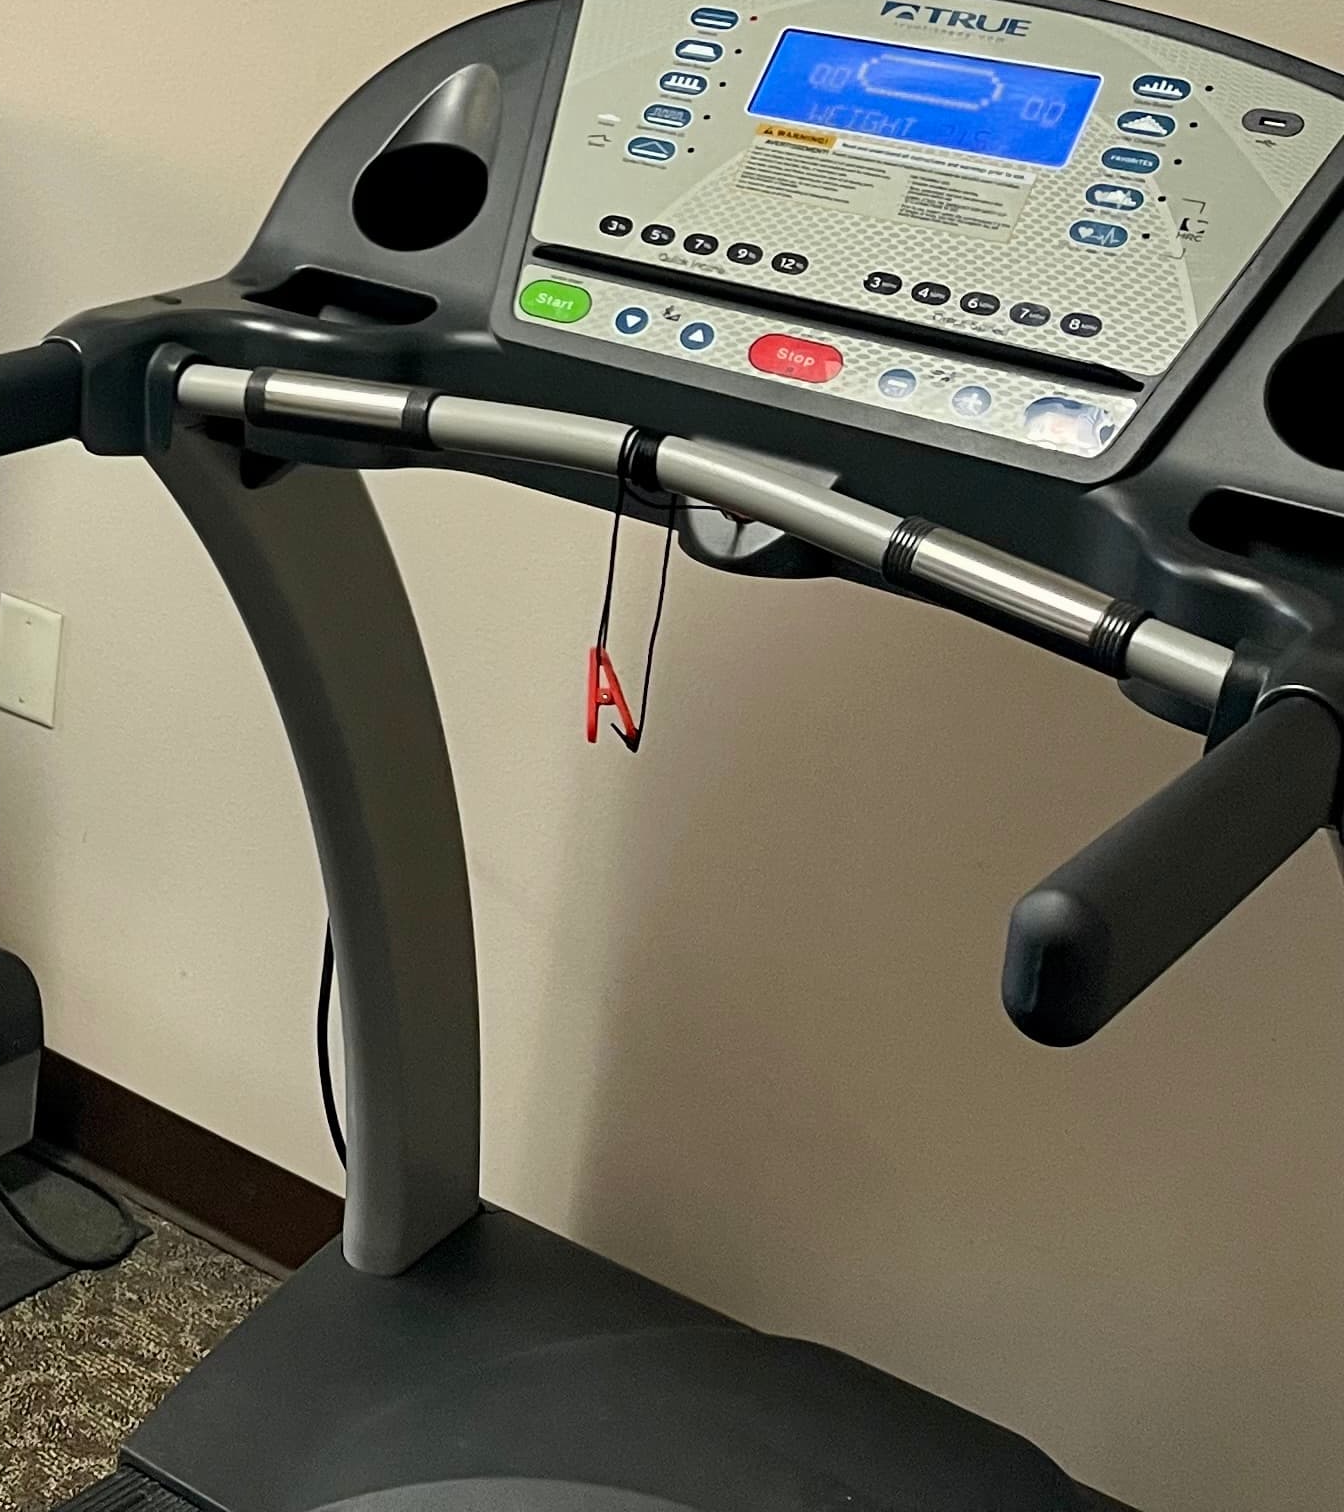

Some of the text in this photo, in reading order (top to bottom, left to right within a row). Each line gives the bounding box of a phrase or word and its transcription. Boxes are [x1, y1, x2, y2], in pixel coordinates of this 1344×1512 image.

[924, 6, 1032, 37] TRUE
[535, 292, 575, 310] Start
[776, 348, 815, 367] Stop
